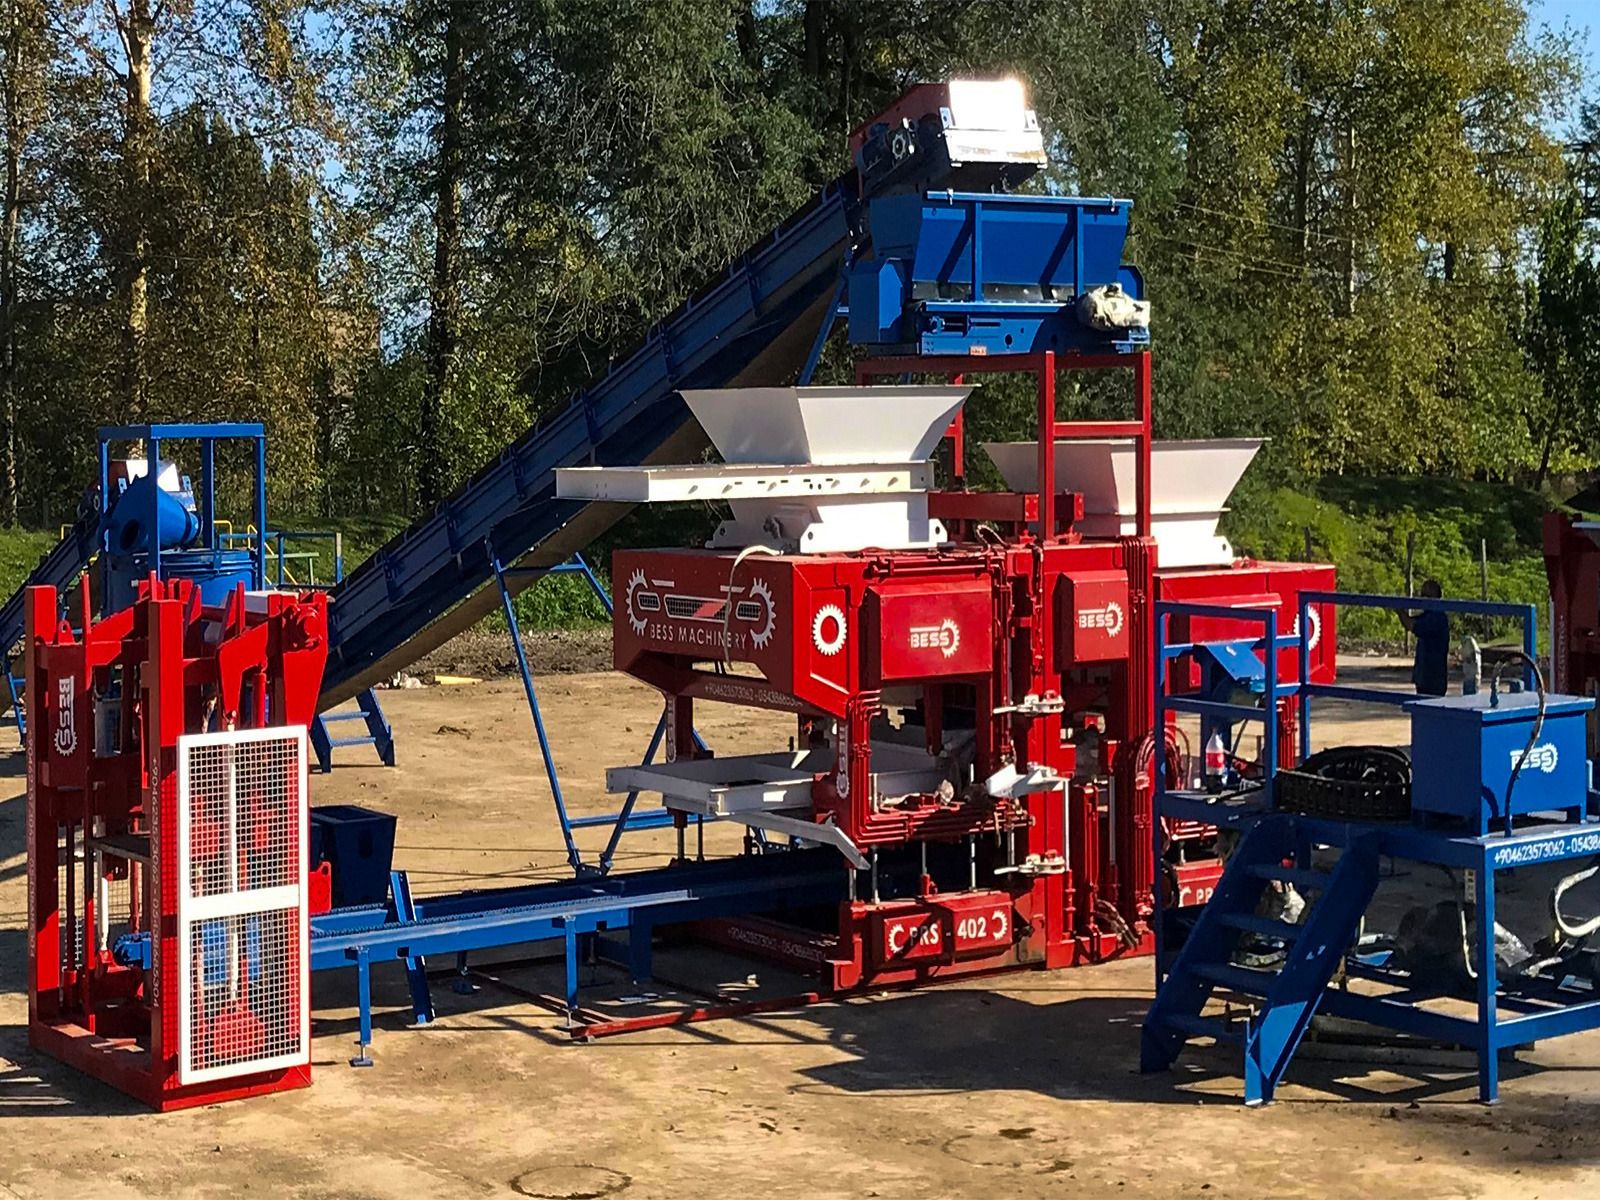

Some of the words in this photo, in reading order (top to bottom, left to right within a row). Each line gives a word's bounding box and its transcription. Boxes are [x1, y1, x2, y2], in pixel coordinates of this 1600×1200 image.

[650, 623, 674, 642] BESS
[678, 626, 747, 649] MACHINERY
[1494, 839, 1565, 865] +904623573062
[909, 922, 939, 946] PRS
[957, 916, 987, 939] 402
